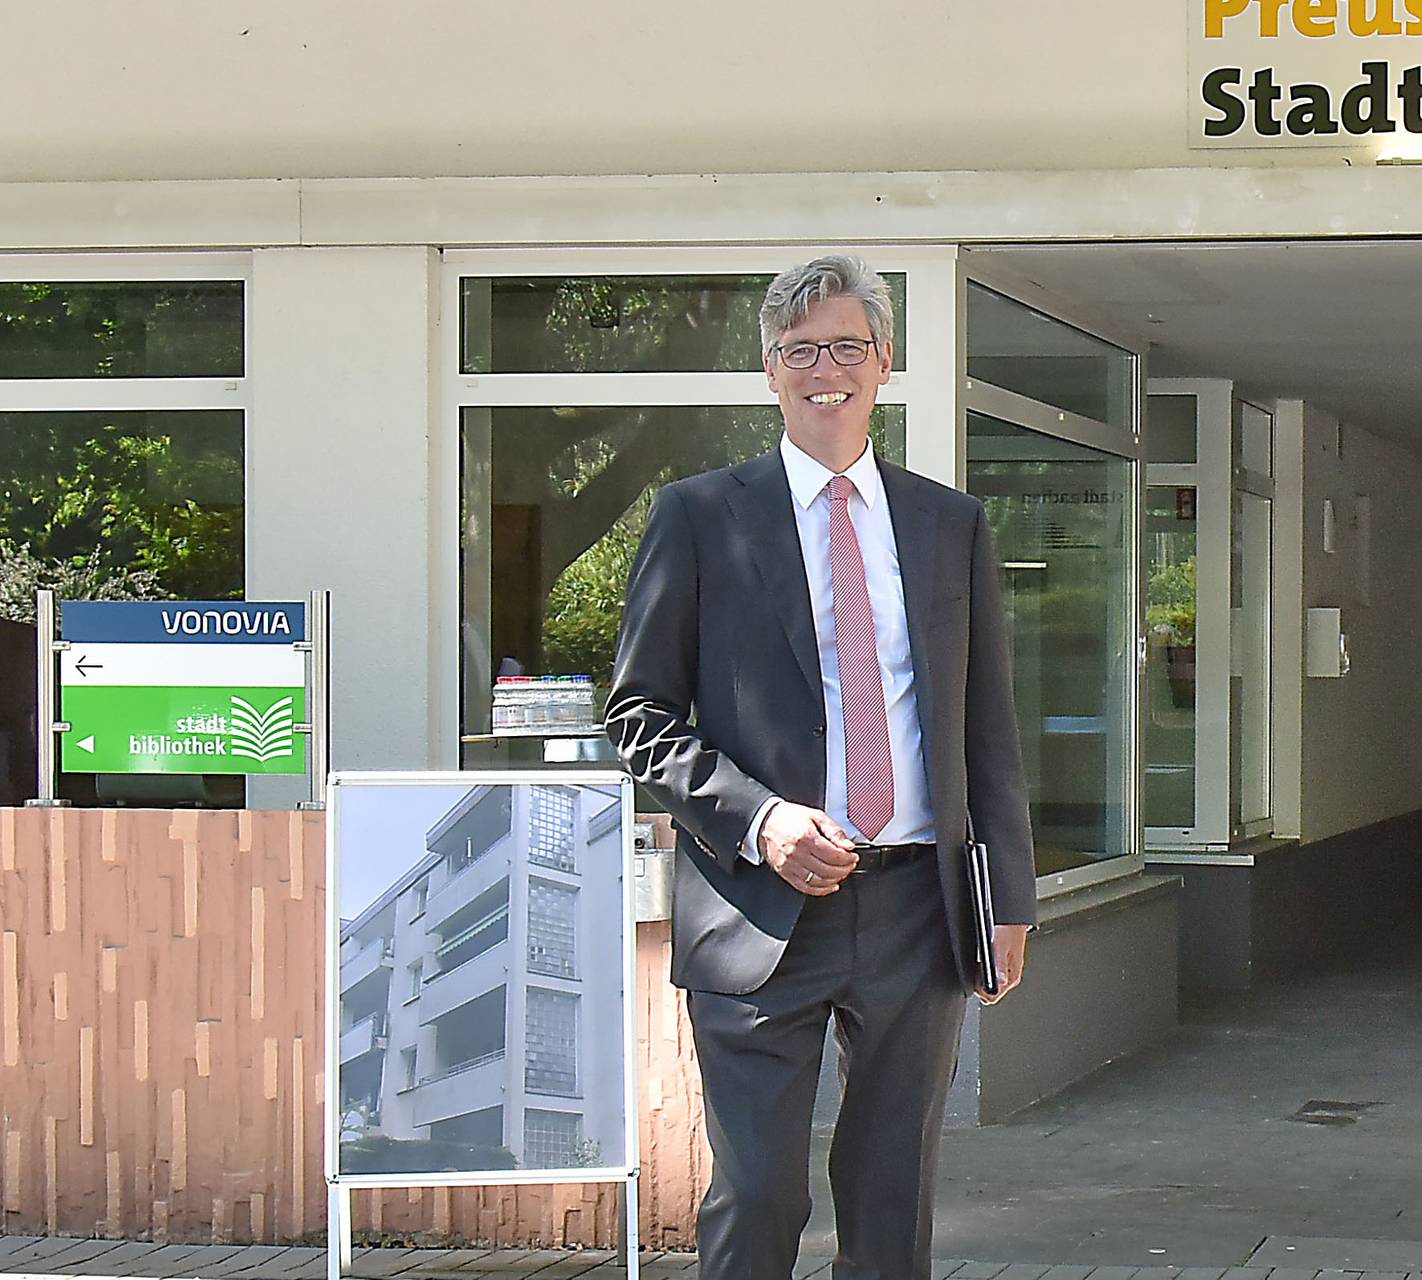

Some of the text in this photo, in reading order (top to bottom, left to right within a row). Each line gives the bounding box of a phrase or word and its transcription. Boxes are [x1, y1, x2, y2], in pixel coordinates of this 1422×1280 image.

[161, 610, 291, 635] VONOVIA
[176, 714, 227, 733] stadt
[129, 735, 226, 755] bibliothek
